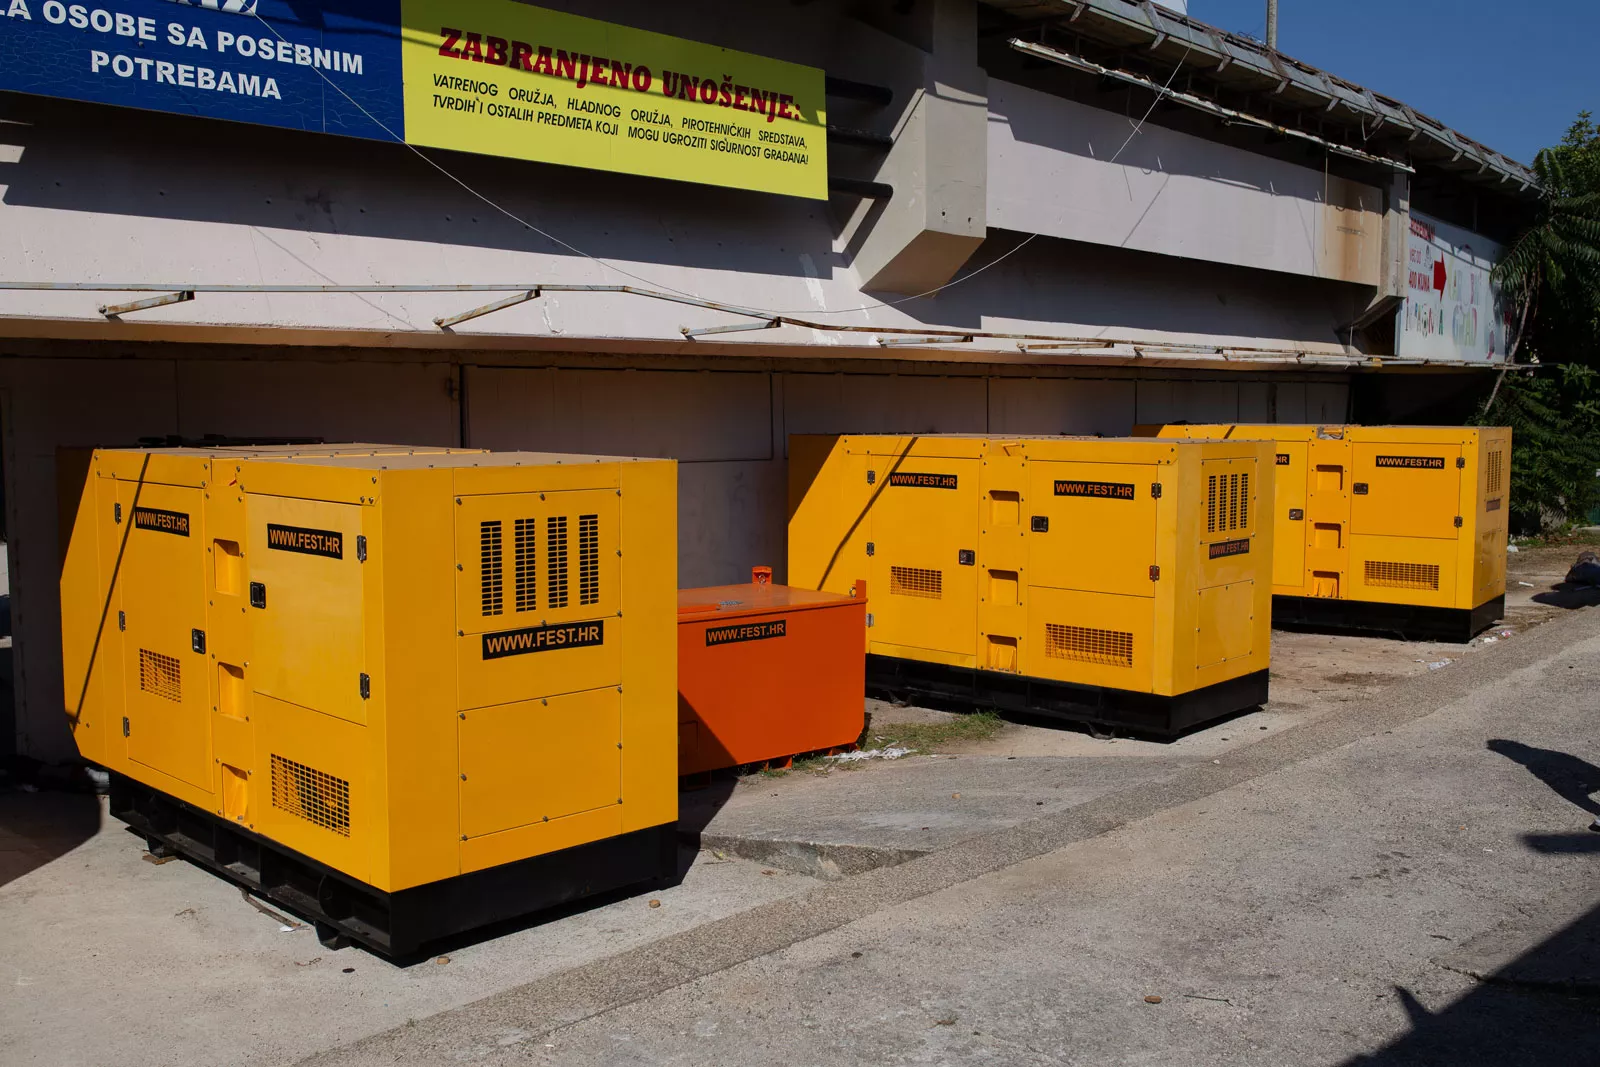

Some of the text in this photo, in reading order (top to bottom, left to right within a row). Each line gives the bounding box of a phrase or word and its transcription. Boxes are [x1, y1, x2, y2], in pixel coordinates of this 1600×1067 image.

[43, 0, 157, 42] OSOBE
[167, 22, 209, 51] SA
[217, 31, 364, 76] POSEBNIM
[91, 50, 282, 100] POTREBAMA
[438, 27, 802, 123] ZABRANJENO UNOŠENJE:
[432, 73, 809, 150] VATRENOG ORUŽJA, HLADNOG ORUŽJA, PIROTEHNIČKIH SREDSTAVA,
[432, 94, 476, 114] TVRDIH
[479, 99, 484, 115] I
[487, 102, 534, 123] OSTALIH
[537, 112, 594, 133] PREDMETA
[595, 120, 620, 137] KOJI
[627, 125, 660, 142] MOGU
[662, 131, 708, 149] UGROZITI
[710, 138, 762, 159] SIGURNOST
[1378, 456, 1443, 468] WWW.FEST.HR
[891, 474, 956, 487] WWW.FEST.HR
[1055, 482, 1134, 498] WWW.FEST.HR
[136, 511, 188, 533] WWW.FEST.HR
[269, 528, 341, 554] WWW.FEST.HR
[486, 625, 600, 654] WWW.FEST.HR
[707, 623, 785, 644] WWW.FEST.HR
